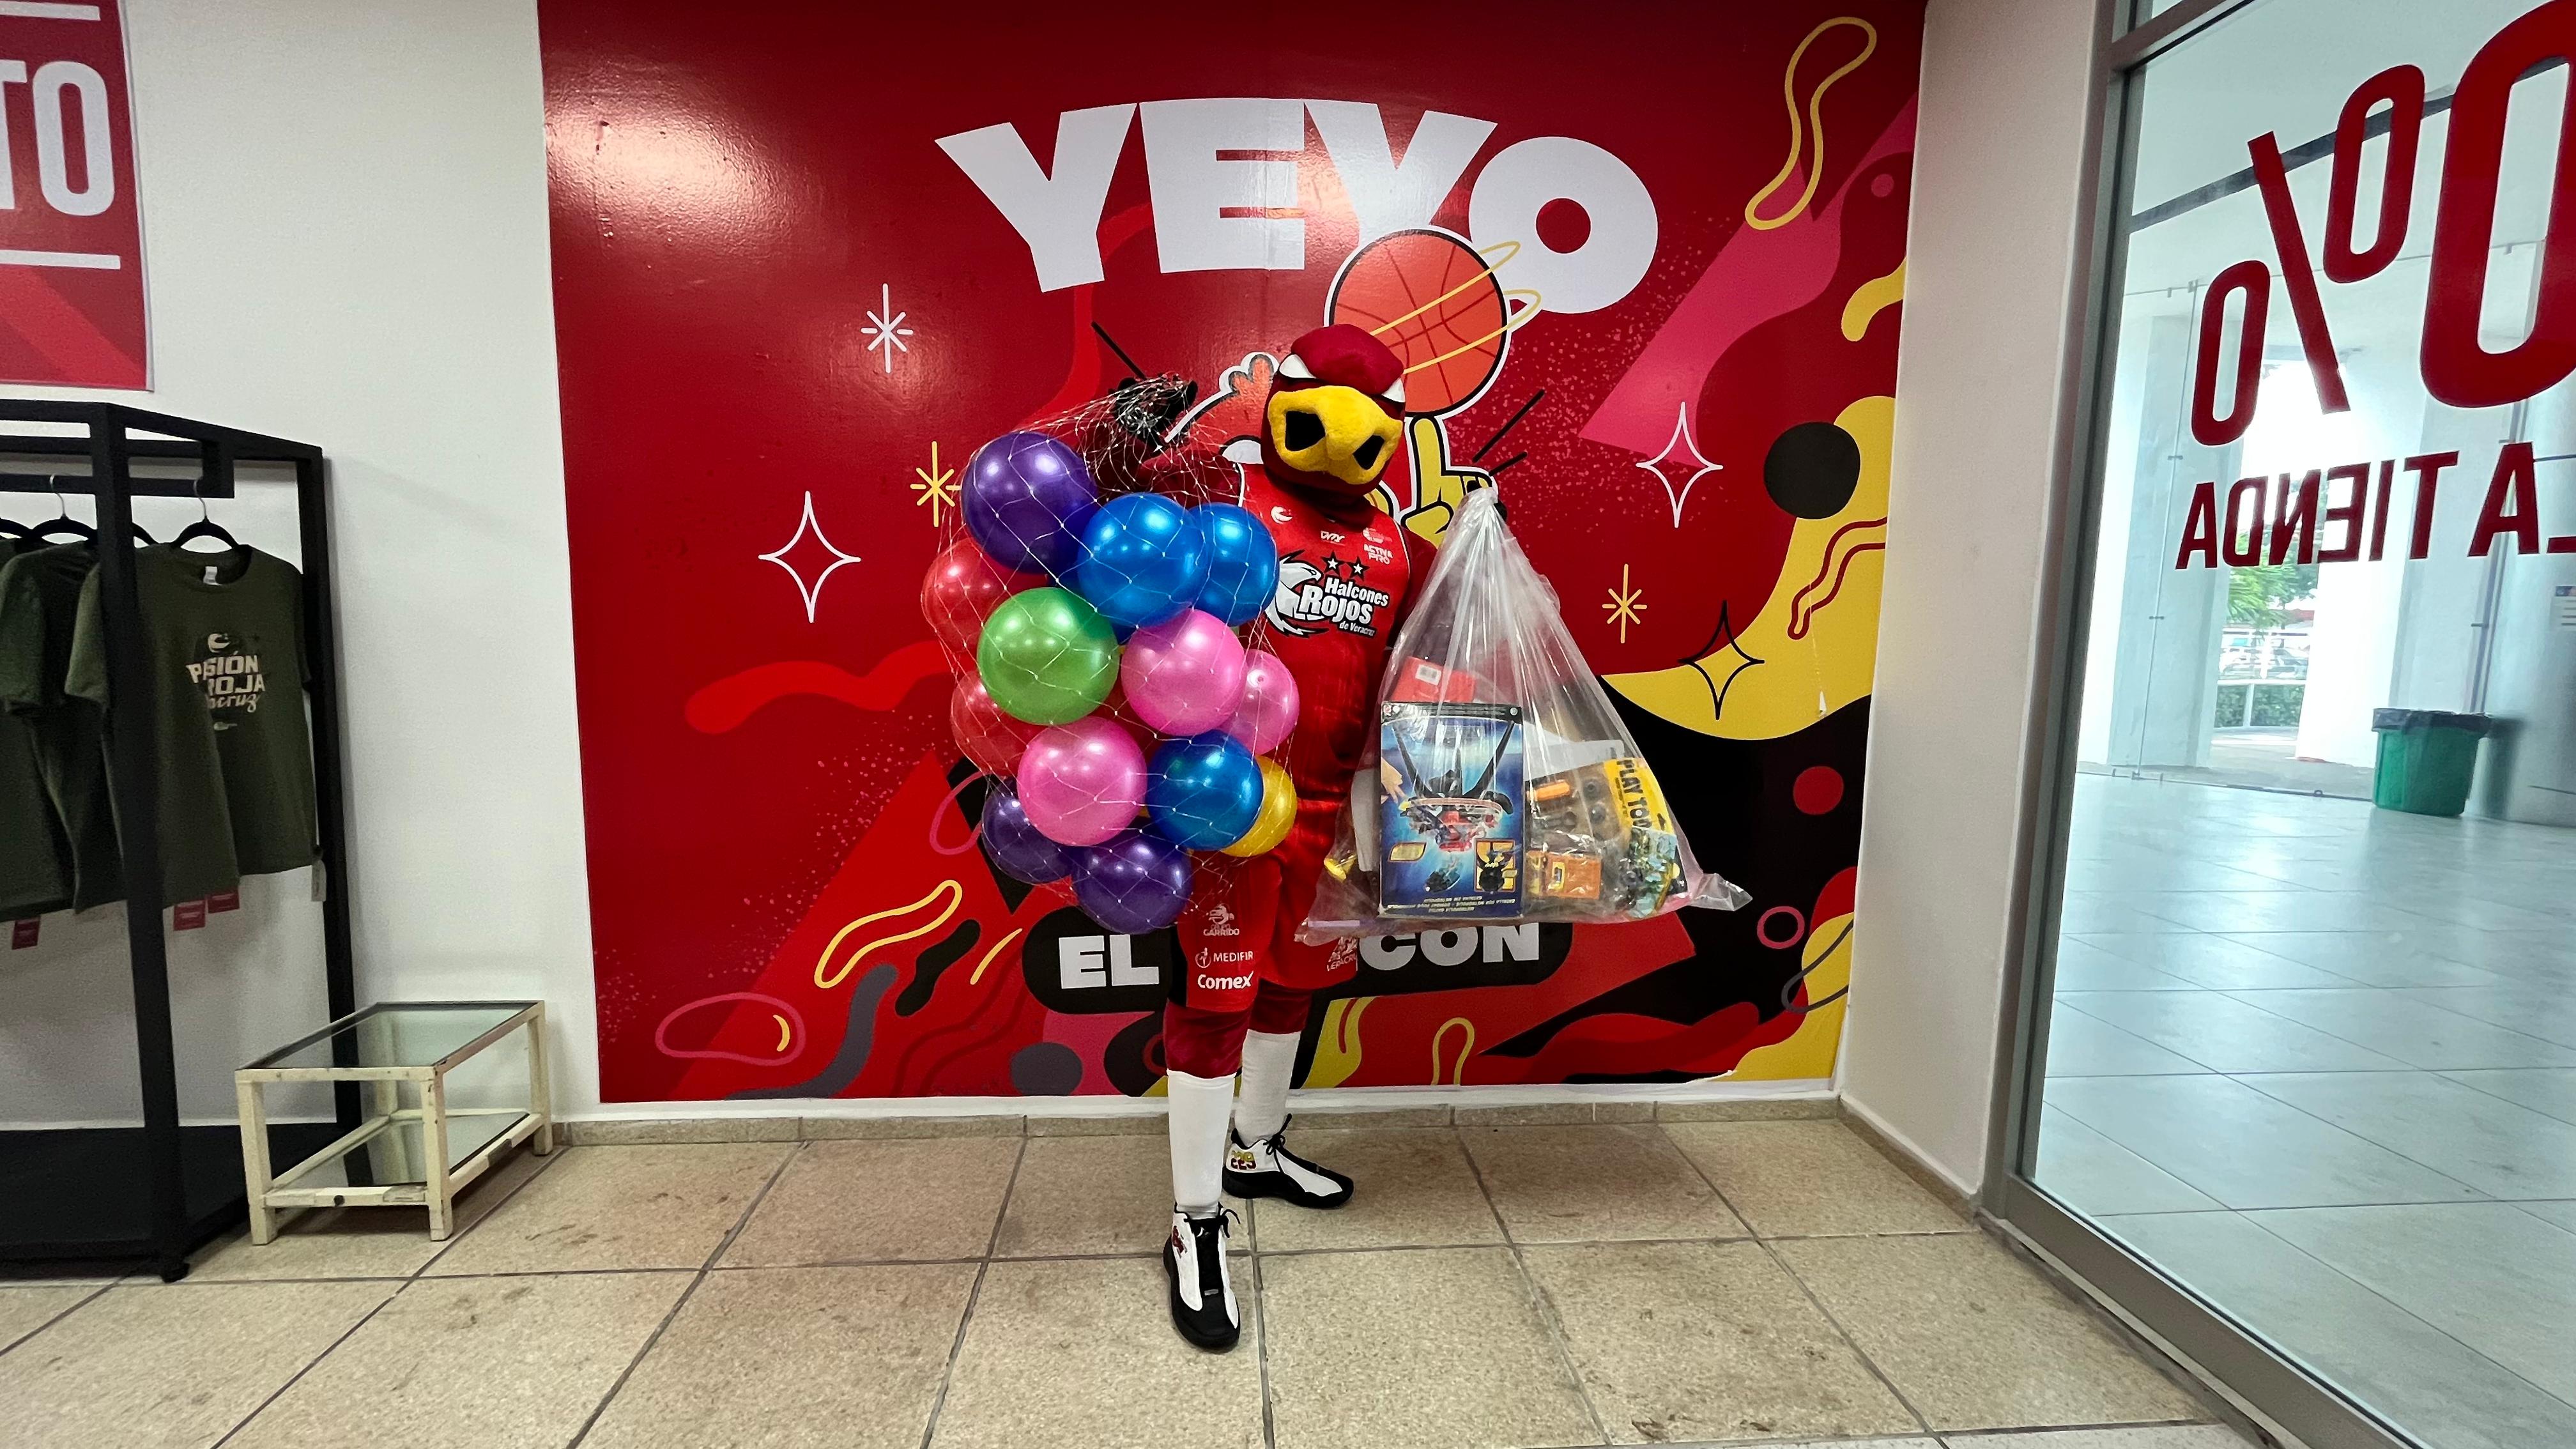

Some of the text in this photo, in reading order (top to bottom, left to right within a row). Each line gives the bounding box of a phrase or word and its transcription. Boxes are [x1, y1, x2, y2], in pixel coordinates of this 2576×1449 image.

[935, 97, 1658, 314] YEYO
[1368, 552, 1390, 565] PRO
[1325, 577, 1388, 606] Halcones
[1339, 621, 1349, 630] de
[1616, 760, 1643, 793] PLAY
[1059, 934, 1160, 989] EL
[1198, 970, 1254, 990] Comex
